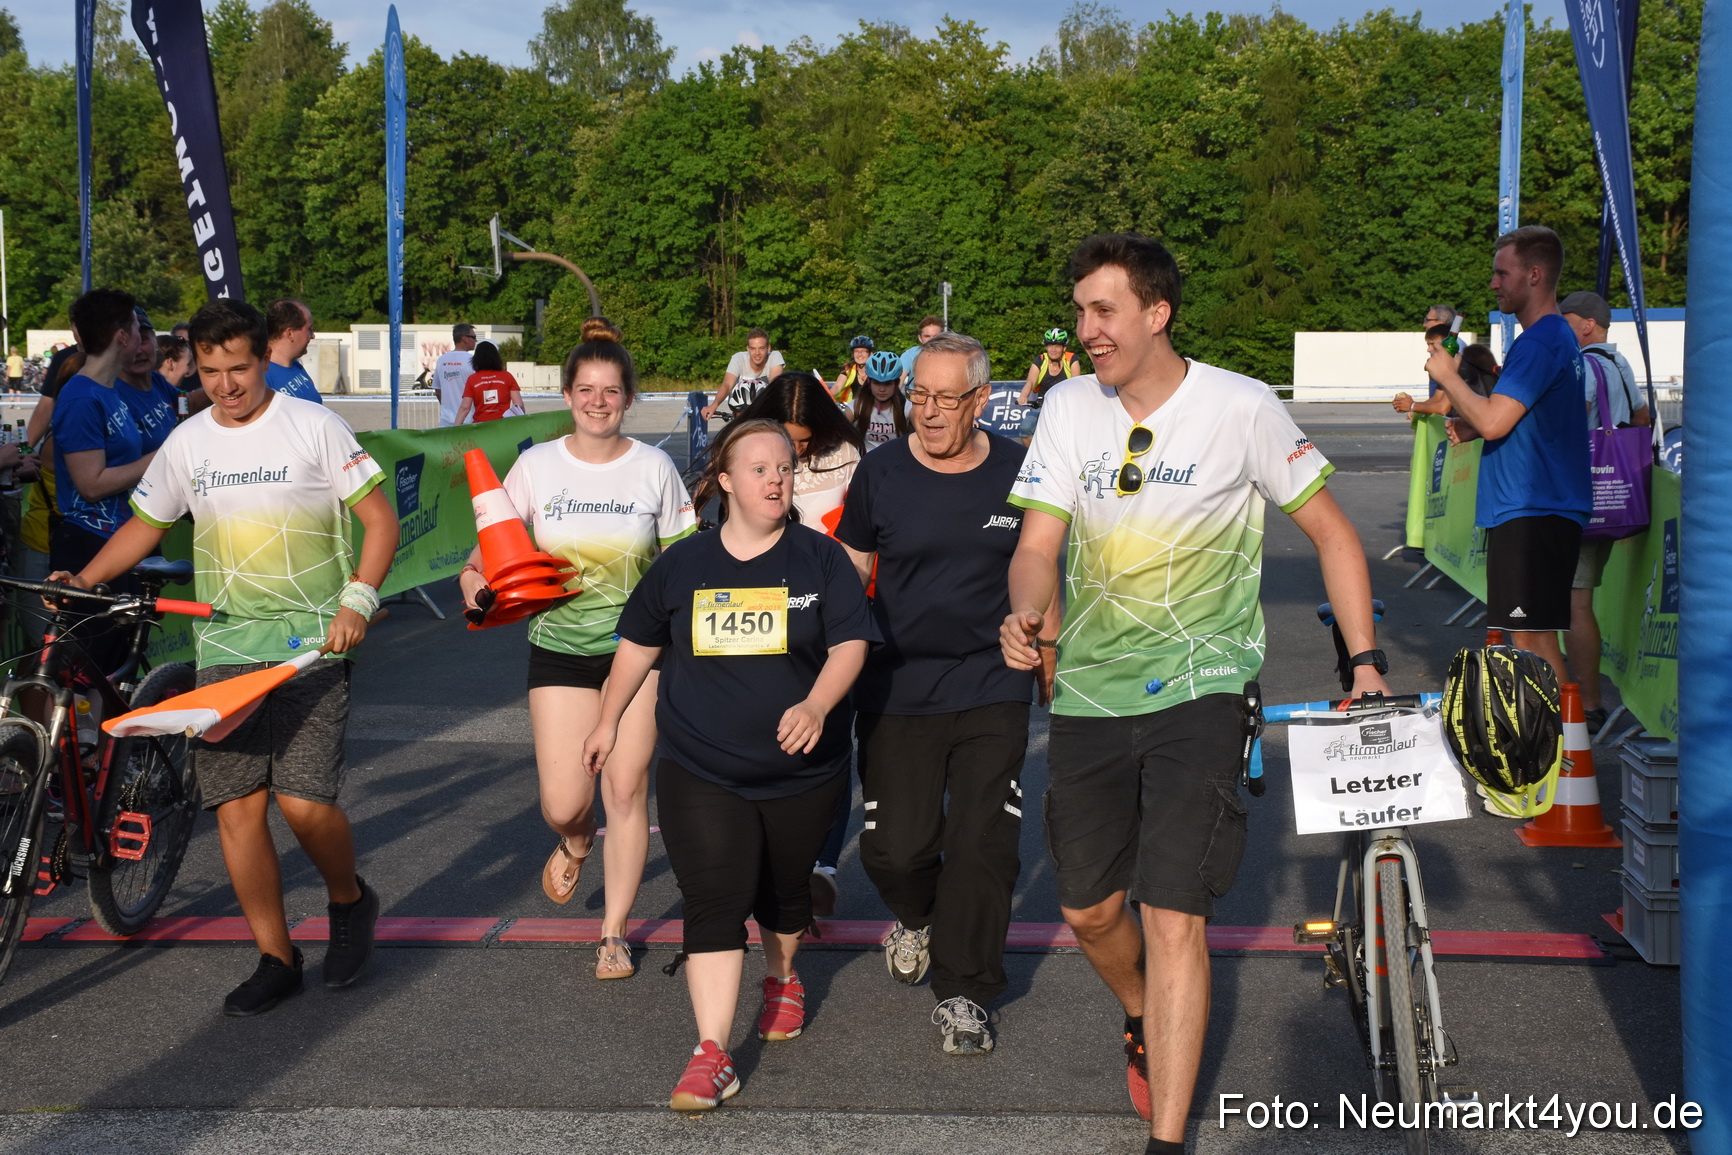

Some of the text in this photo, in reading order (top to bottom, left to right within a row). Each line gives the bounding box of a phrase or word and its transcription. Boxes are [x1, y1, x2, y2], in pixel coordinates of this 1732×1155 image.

[211, 465, 288, 487] firmenlauf
[567, 499, 636, 514] firmenlauf
[705, 611, 774, 636] 1450
[304, 637, 326, 646] your
[1167, 665, 1238, 687] your textile
[1349, 735, 1418, 756] firmenlauf
[1330, 772, 1422, 794] Letzter
[1339, 805, 1422, 827] Läufer
[12, 837, 32, 877] ROCKSHOX
